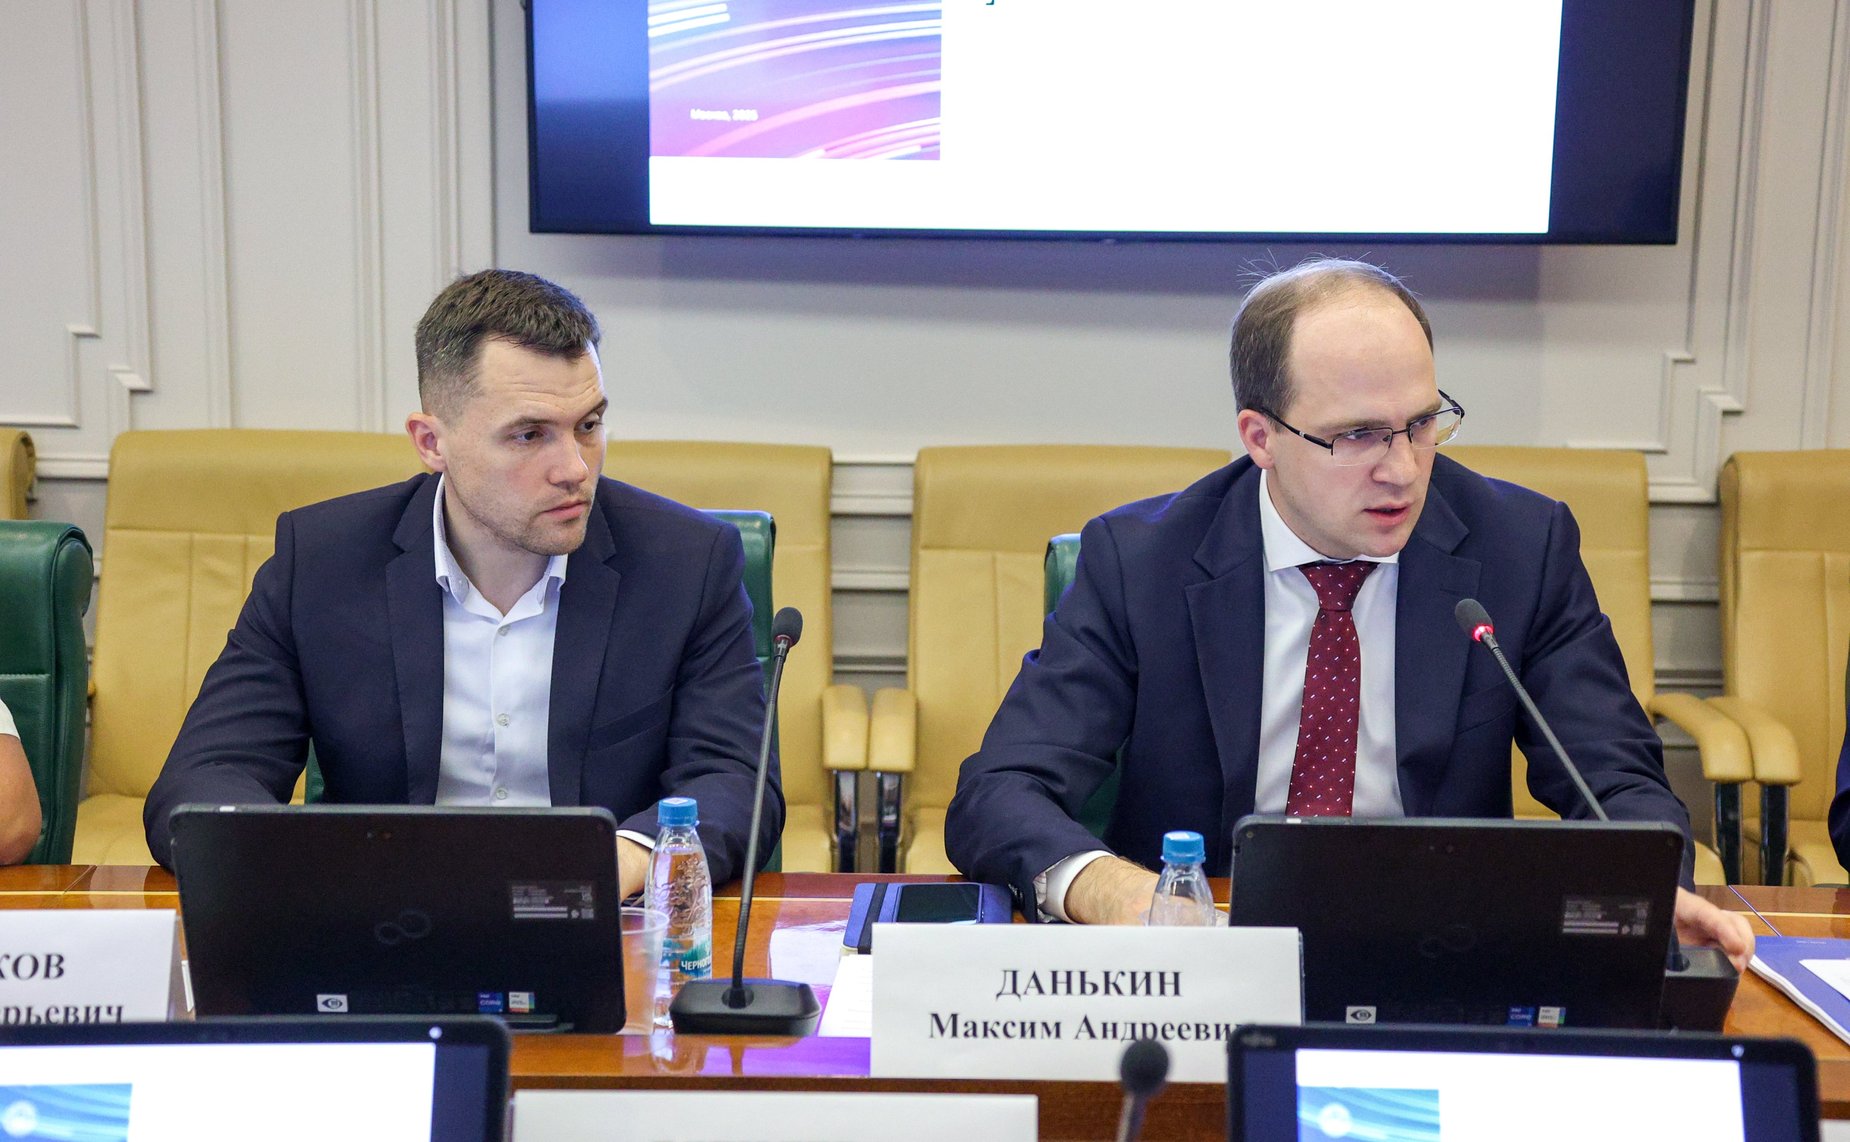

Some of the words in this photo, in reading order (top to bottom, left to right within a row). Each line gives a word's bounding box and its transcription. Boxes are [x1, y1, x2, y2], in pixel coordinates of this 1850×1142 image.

[996, 969, 1183, 1001] ДАНЬКИН
[0, 1005, 124, 1025] рьевич
[929, 1013, 1062, 1040] Максим
[1074, 1014, 1240, 1043] Андрееви
